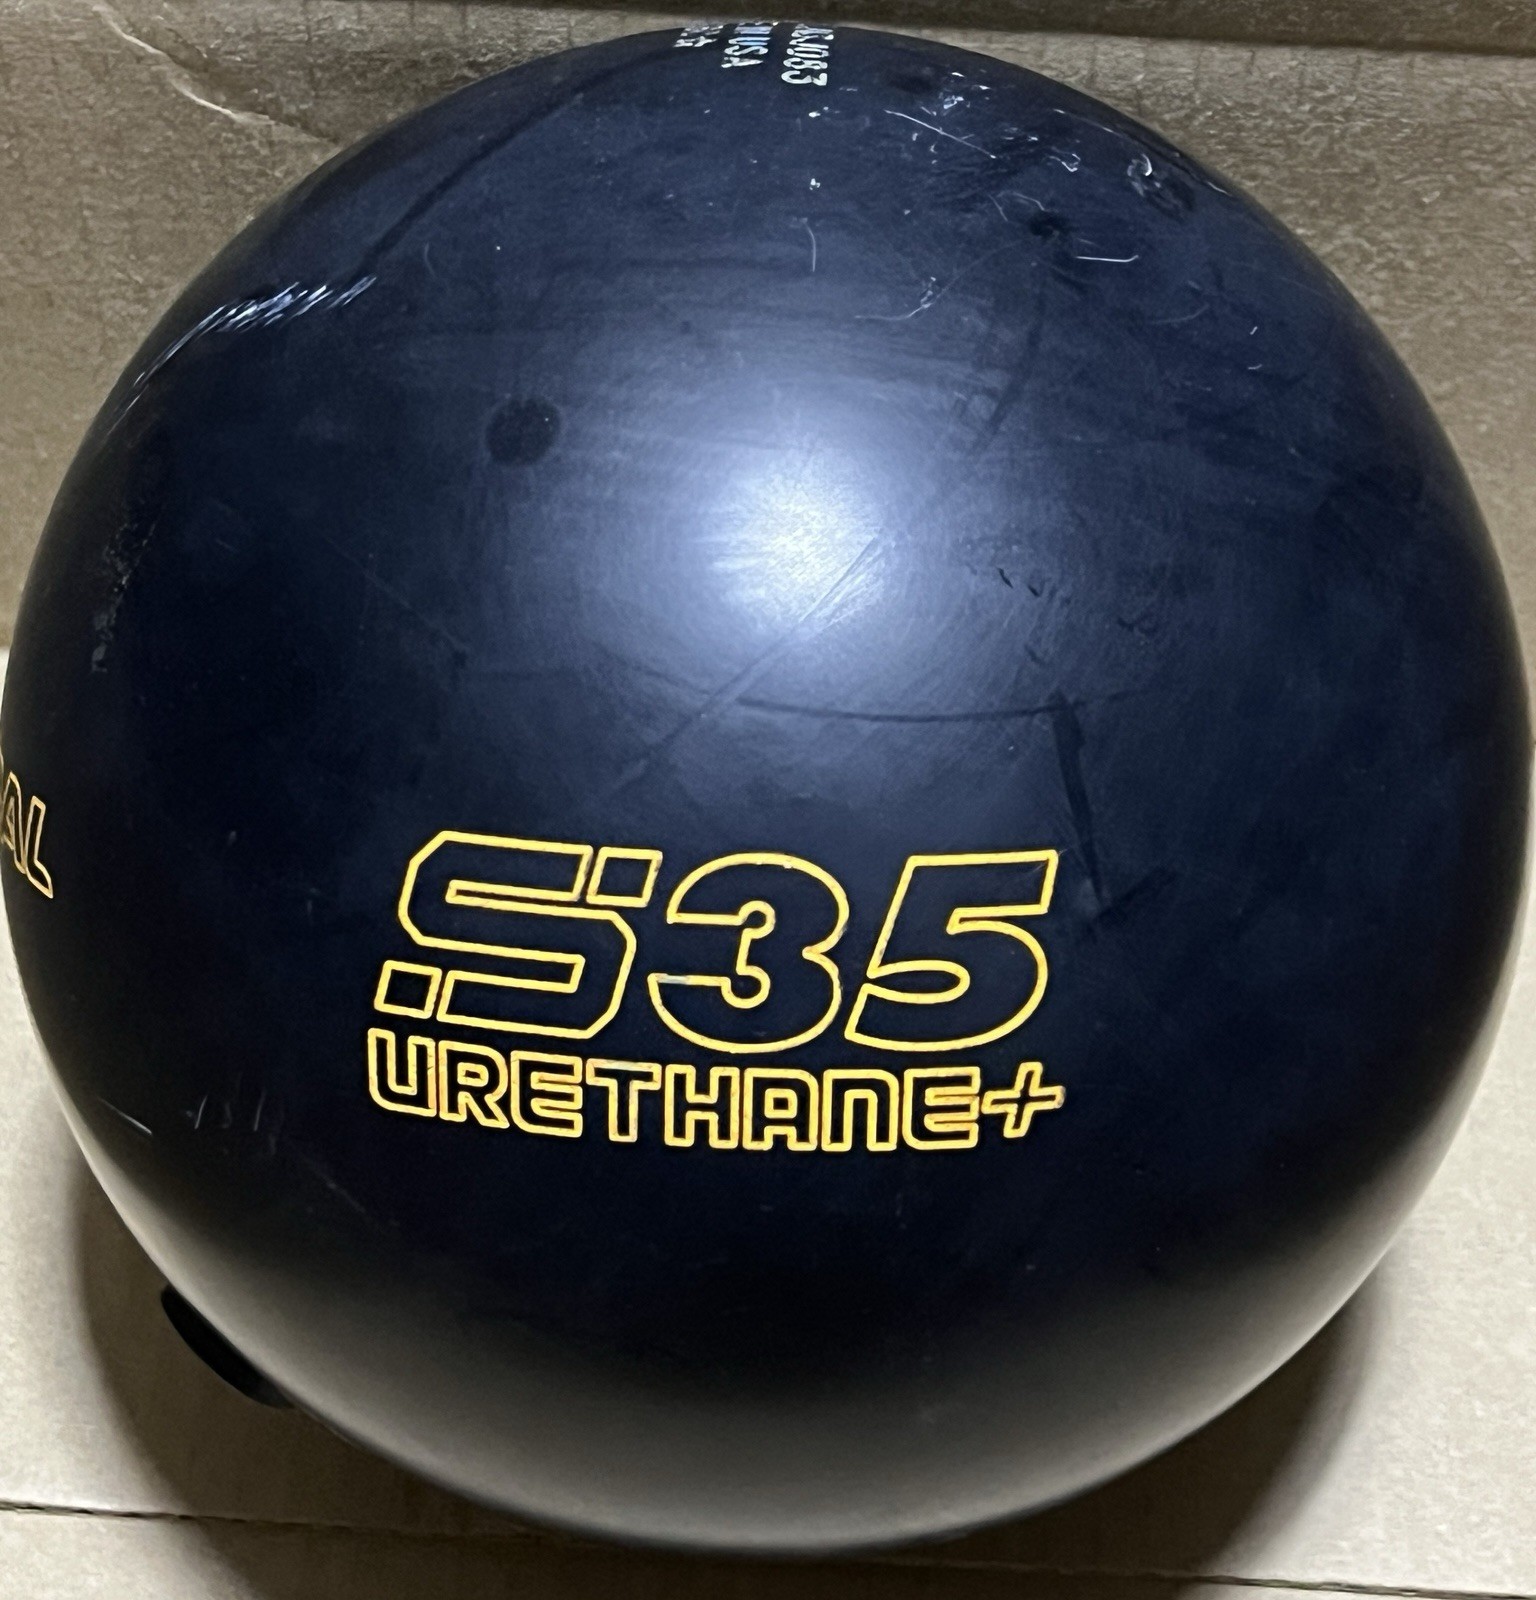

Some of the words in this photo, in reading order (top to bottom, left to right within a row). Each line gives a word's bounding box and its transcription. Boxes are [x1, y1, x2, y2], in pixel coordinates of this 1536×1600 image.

[721, 37, 771, 68] USA
[374, 830, 1059, 1053] S35
[367, 1028, 1066, 1152] URETHANE+
